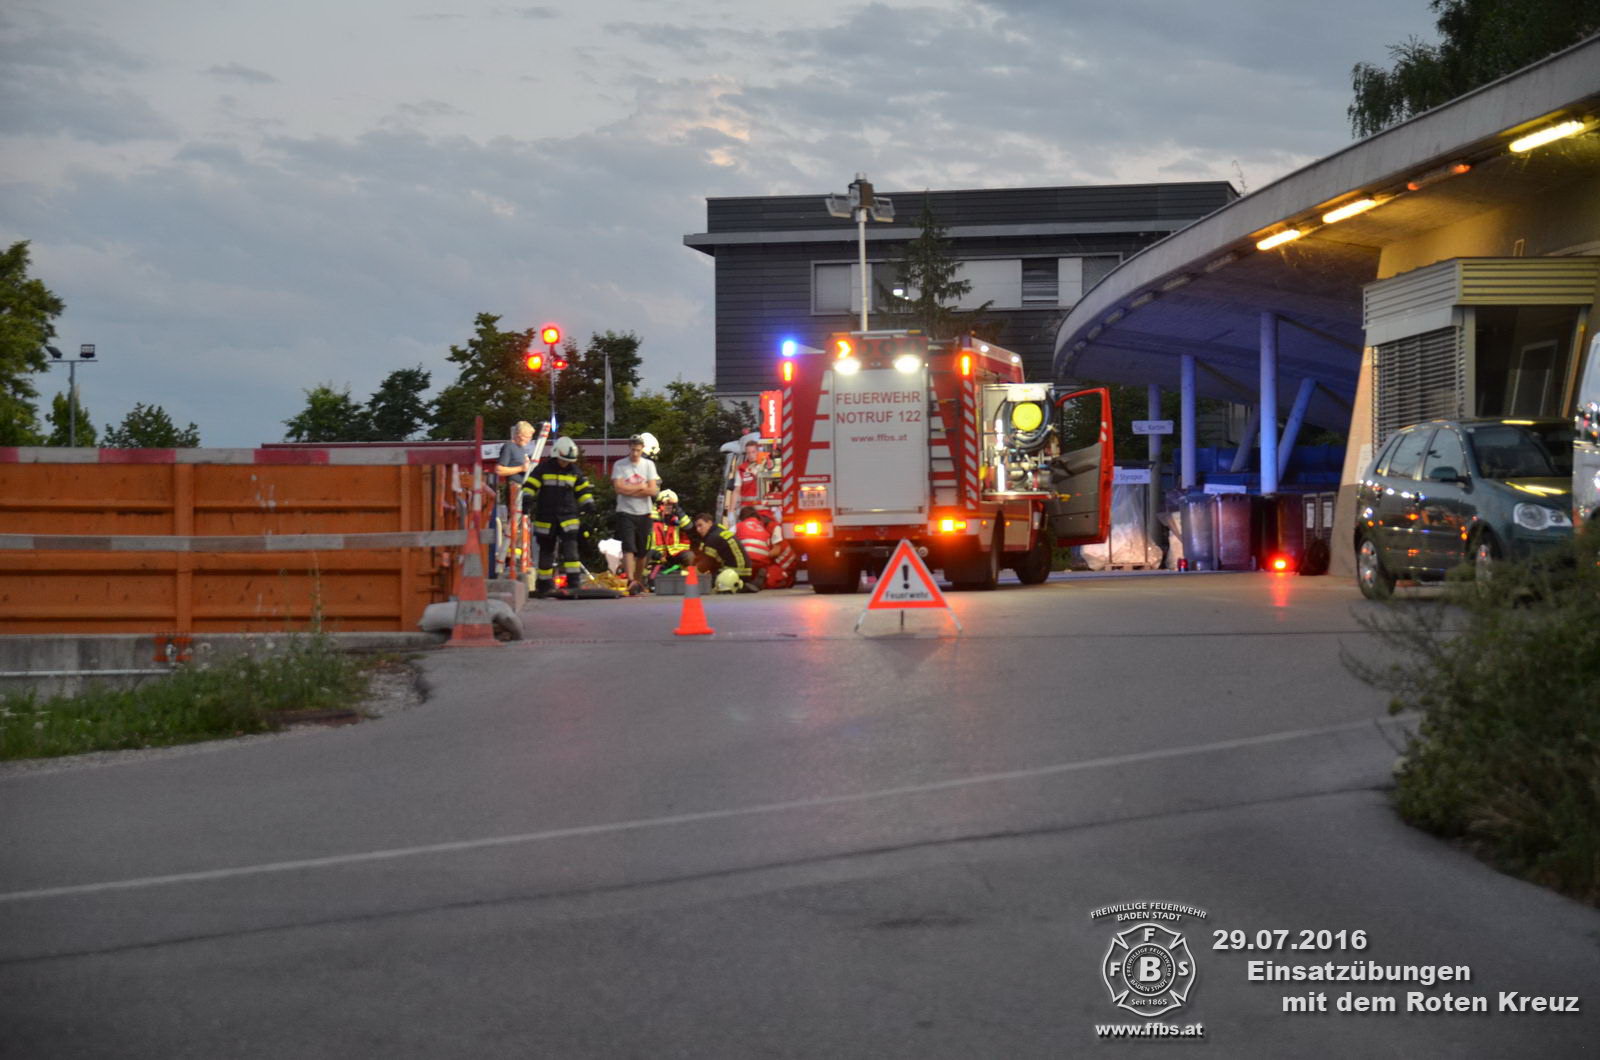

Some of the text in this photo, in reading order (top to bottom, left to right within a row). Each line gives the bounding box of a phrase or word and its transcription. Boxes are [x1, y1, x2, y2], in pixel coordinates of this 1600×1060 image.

[836, 391, 921, 405] FEUERWEHR
[836, 410, 921, 424] NOTRUF 122
[850, 433, 908, 442] www.ffbs.at
